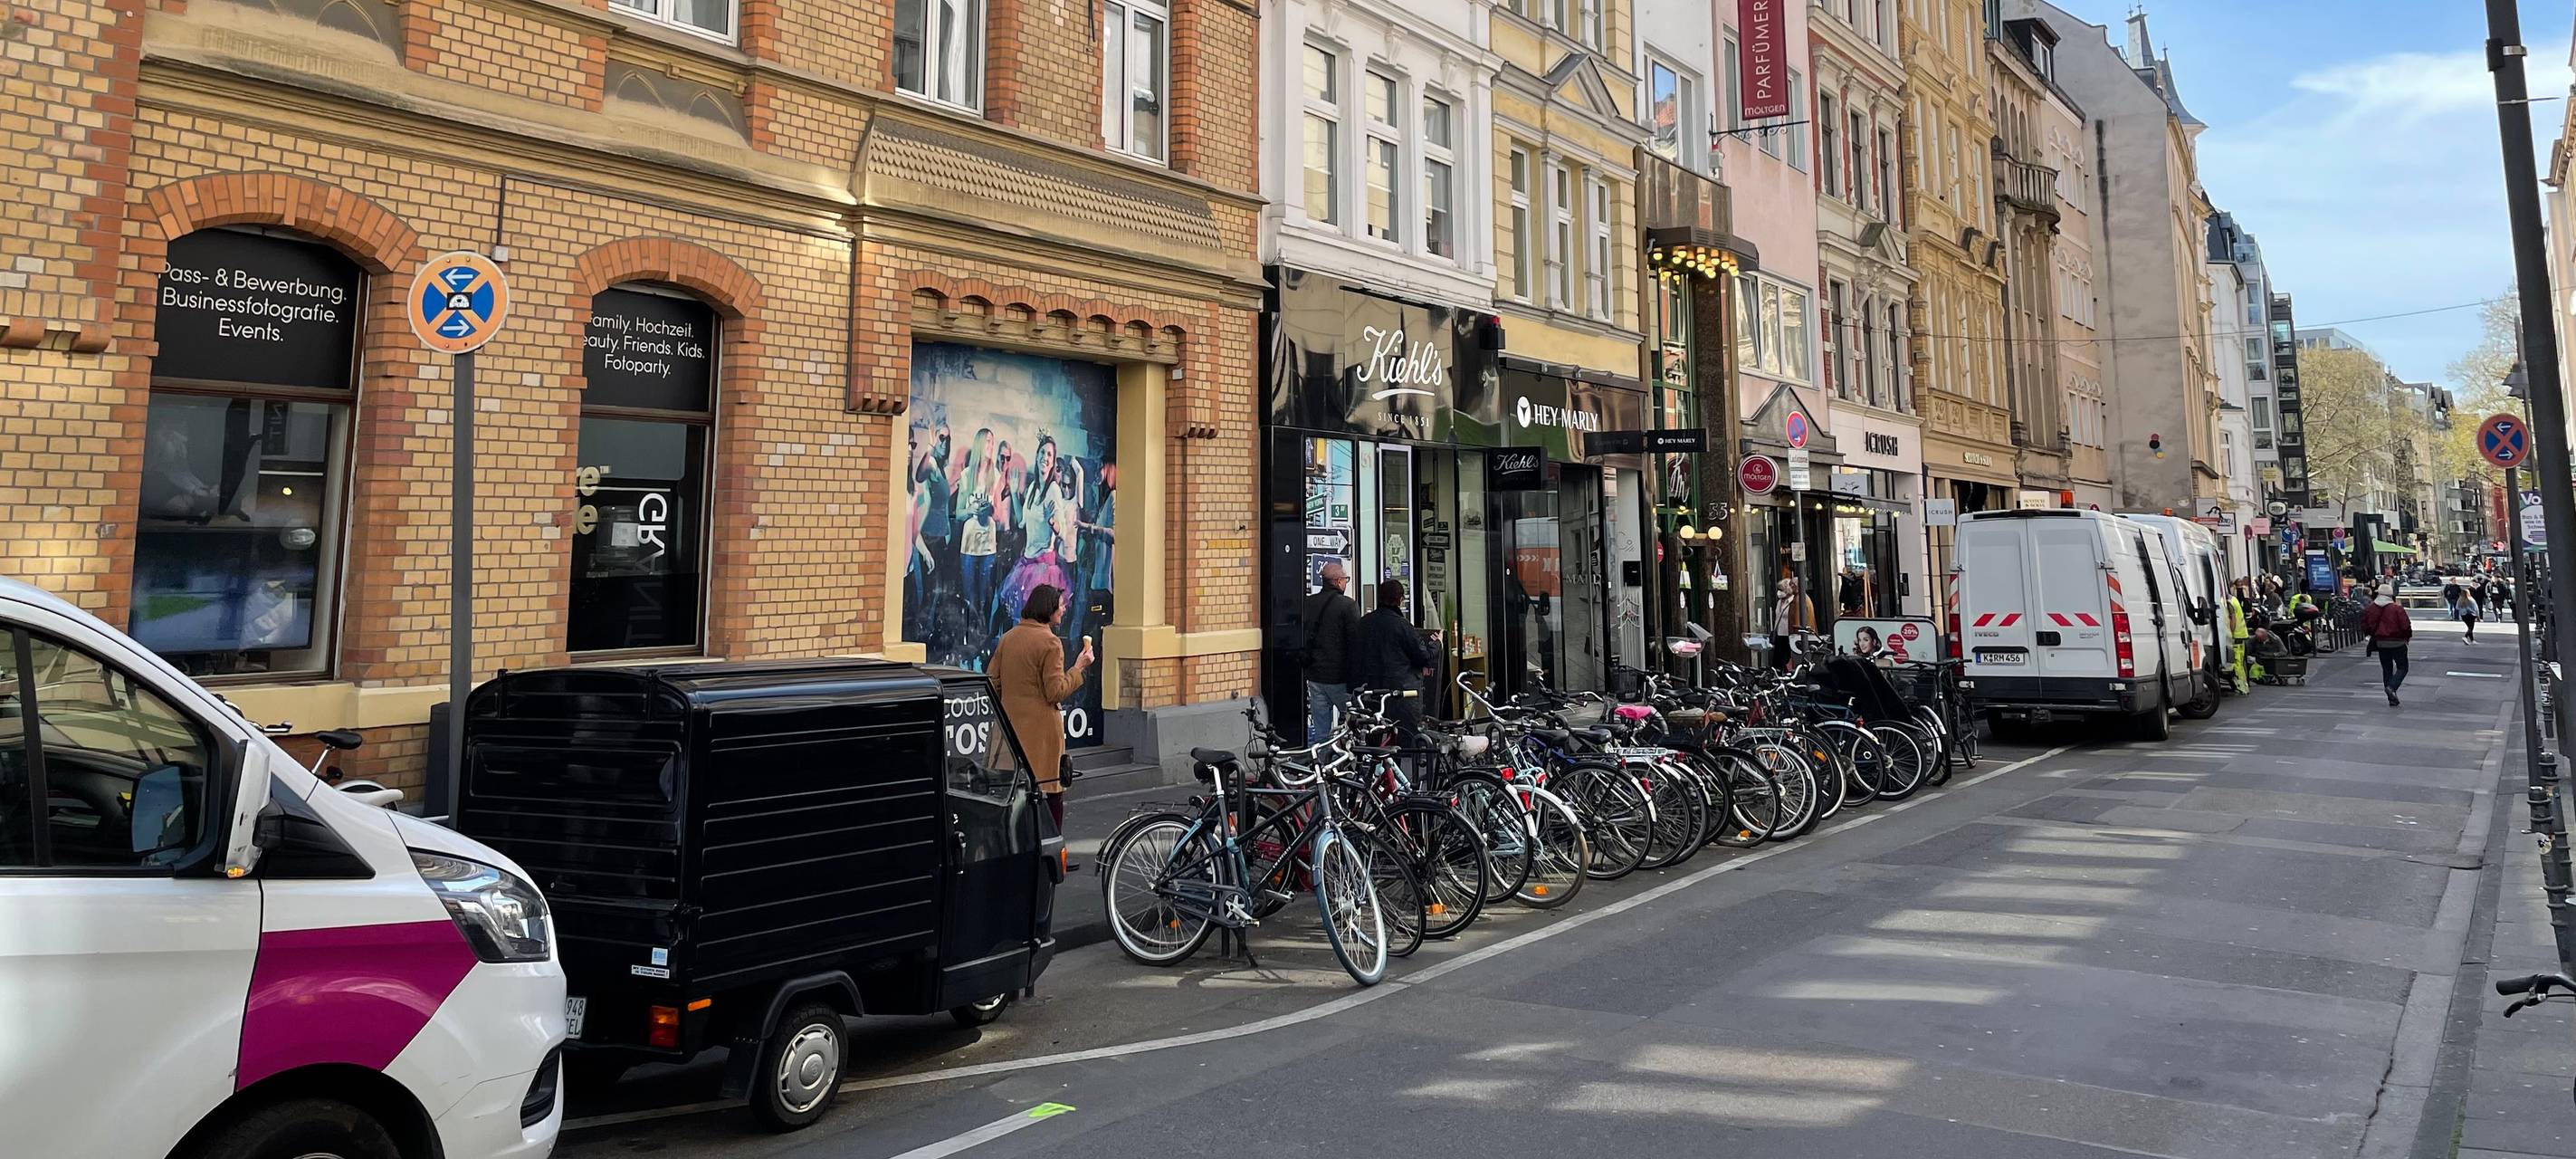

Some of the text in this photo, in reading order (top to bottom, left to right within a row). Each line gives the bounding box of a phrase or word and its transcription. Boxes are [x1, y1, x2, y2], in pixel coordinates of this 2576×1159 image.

[1752, 0, 1772, 99] PARFÜMER
[158, 261, 348, 305] Pass- & Bewerbung.
[162, 286, 339, 323] Businessfotografie.
[218, 317, 284, 342] Events.
[635, 317, 694, 338] Hochzeit.
[624, 335, 673, 356] Friends.
[677, 341, 705, 359] Kids.
[1356, 325, 1443, 386] Kiehl's
[605, 353, 672, 378] Fotoparty.
[1378, 411, 1430, 428] SINCE 1851
[1534, 404, 1598, 432] HEY MARLY
[1865, 431, 1899, 456] ICRUSH
[1493, 453, 1539, 470] Kiehl's
[1335, 505, 1340, 516] 3
[1312, 536, 1341, 547] ONE WAY
[2281, 543, 2287, 553] P
[1983, 654, 1989, 662] K
[2005, 654, 2020, 662] 456
[945, 722, 994, 756] TOS
[567, 999, 585, 1016] 948
